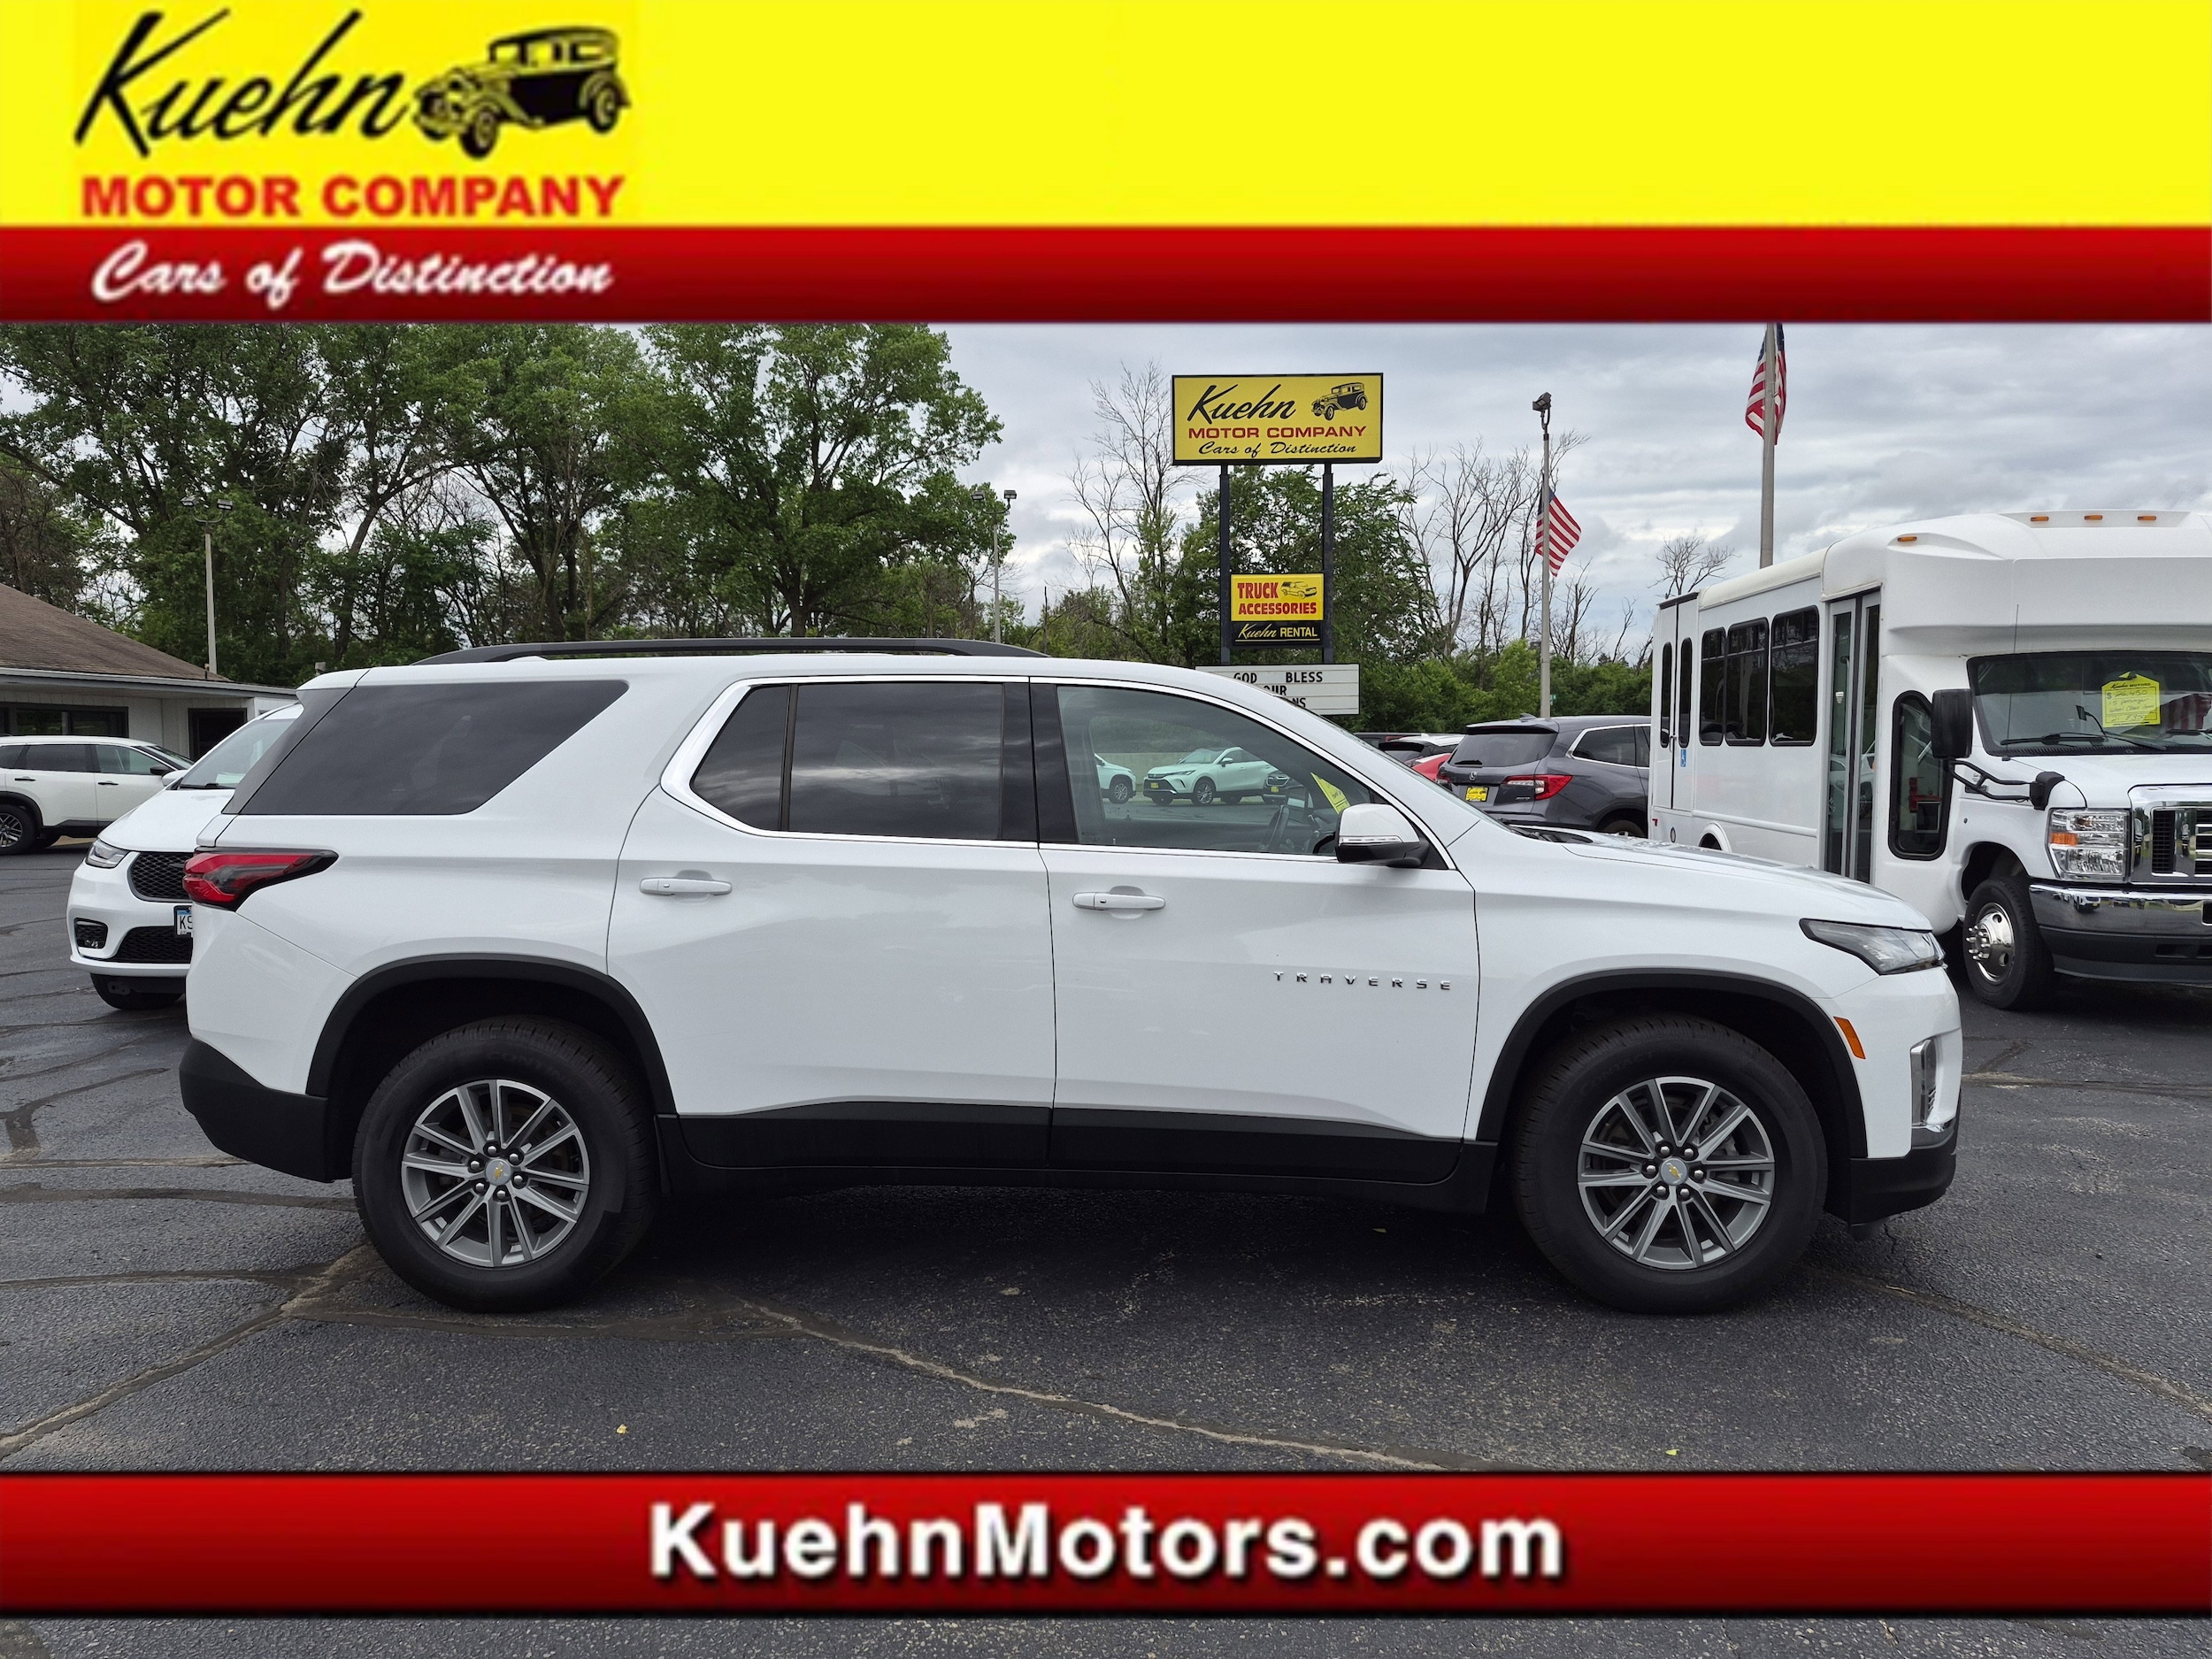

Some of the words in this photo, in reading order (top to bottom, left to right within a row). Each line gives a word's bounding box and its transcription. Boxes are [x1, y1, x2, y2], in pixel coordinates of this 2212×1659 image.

[1187, 383, 1296, 425] Kuehn
[1188, 428, 1259, 439] MOTOR
[1267, 426, 1366, 438] COMPANY
[1198, 442, 1240, 455] Cars
[1244, 443, 1262, 458] of
[1270, 442, 1356, 454] Distinction
[1237, 582, 1279, 599] TRUCK
[1238, 603, 1317, 615] ACCESSORIES
[1238, 623, 1277, 640] Kuehn
[1279, 626, 1318, 637] RENTAL
[1233, 672, 1257, 684] GOD
[1286, 672, 1323, 683] BLESS
[1273, 970, 1452, 991] TRAVERSE
